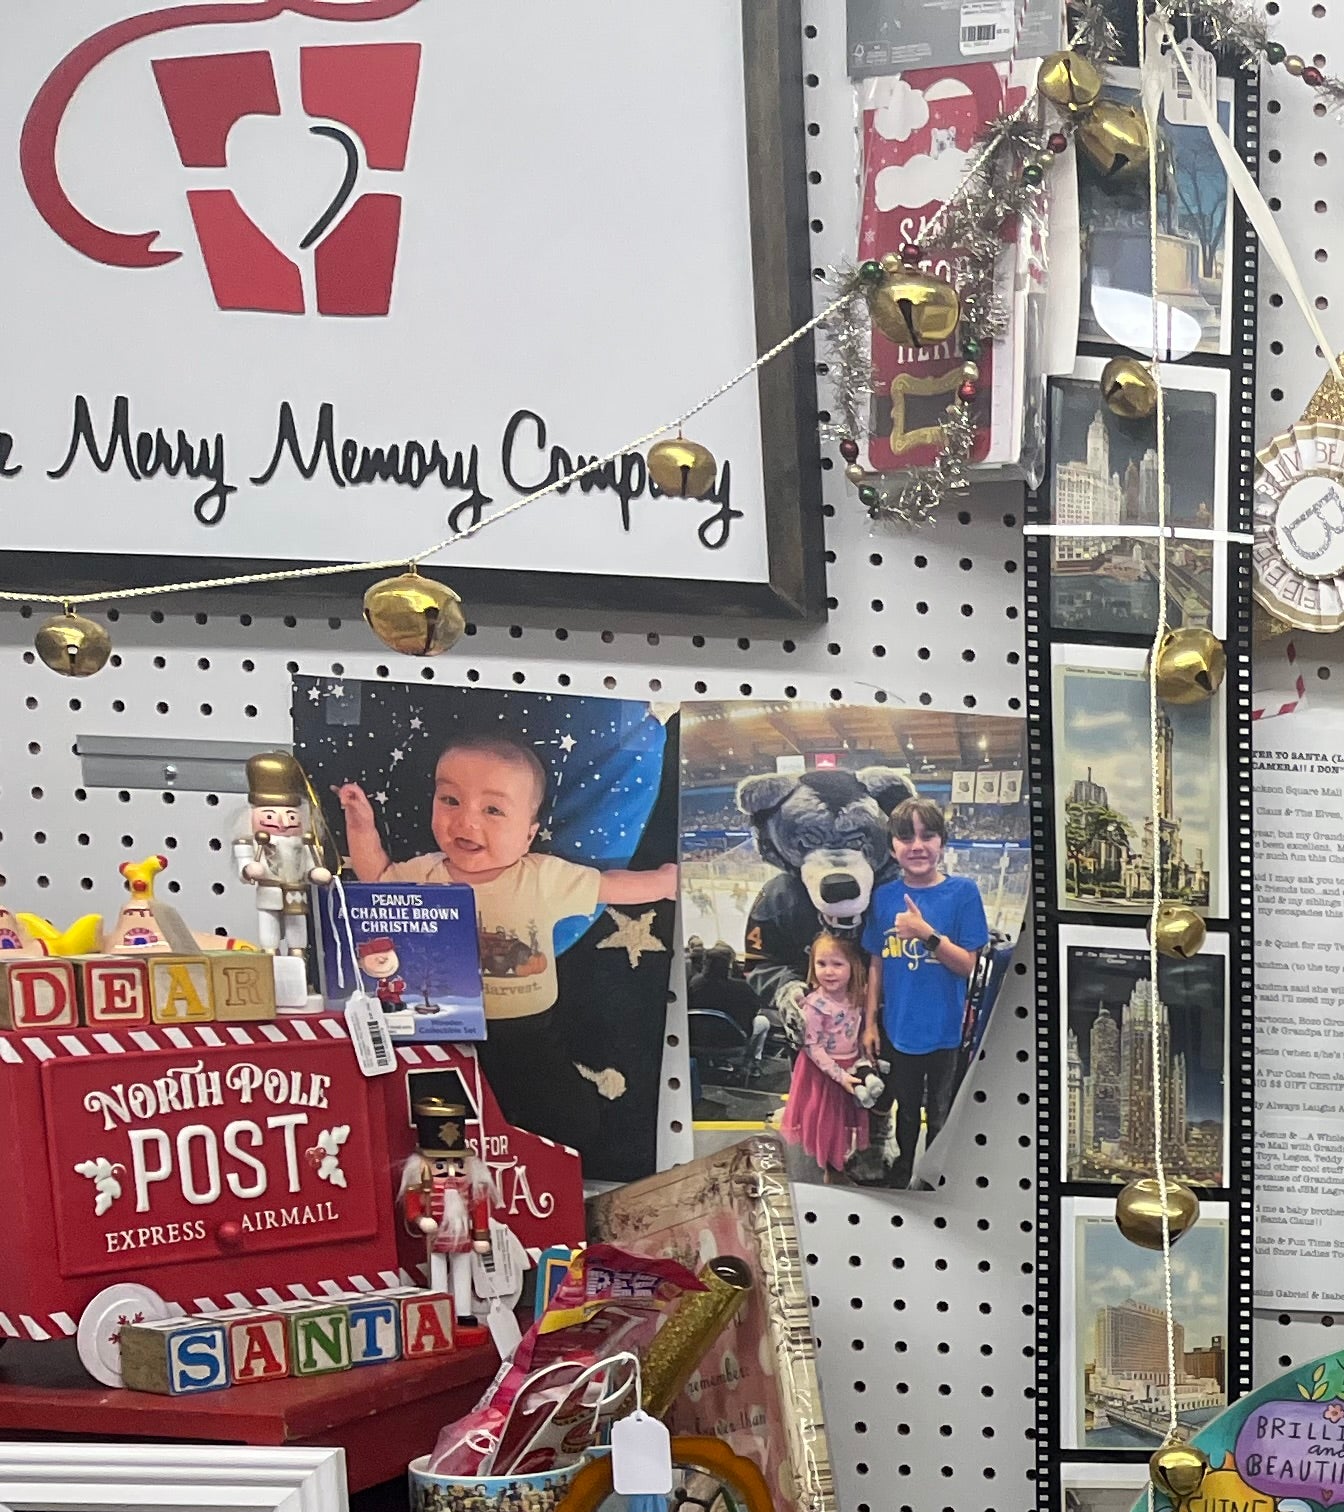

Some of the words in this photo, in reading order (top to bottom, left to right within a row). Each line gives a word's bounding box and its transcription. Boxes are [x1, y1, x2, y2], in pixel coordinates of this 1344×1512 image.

[48, 395, 238, 526] Merry
[252, 402, 494, 535] Memory
[1291, 752, 1329, 761] SANTA
[351, 908, 409, 920] CHARLIE
[413, 908, 459, 920] BROWN
[361, 921, 438, 933] CHRISTMAS
[372, 894, 423, 906] PEANUTS
[19, 964, 262, 1024] DEAR
[84, 1060, 221, 1130] NORTH
[226, 1062, 331, 1109] POLE
[128, 1113, 309, 1212] POST
[105, 1220, 206, 1253] EXPRESS
[241, 1202, 339, 1232] AIRMAIL
[178, 1303, 447, 1388] SANTA
